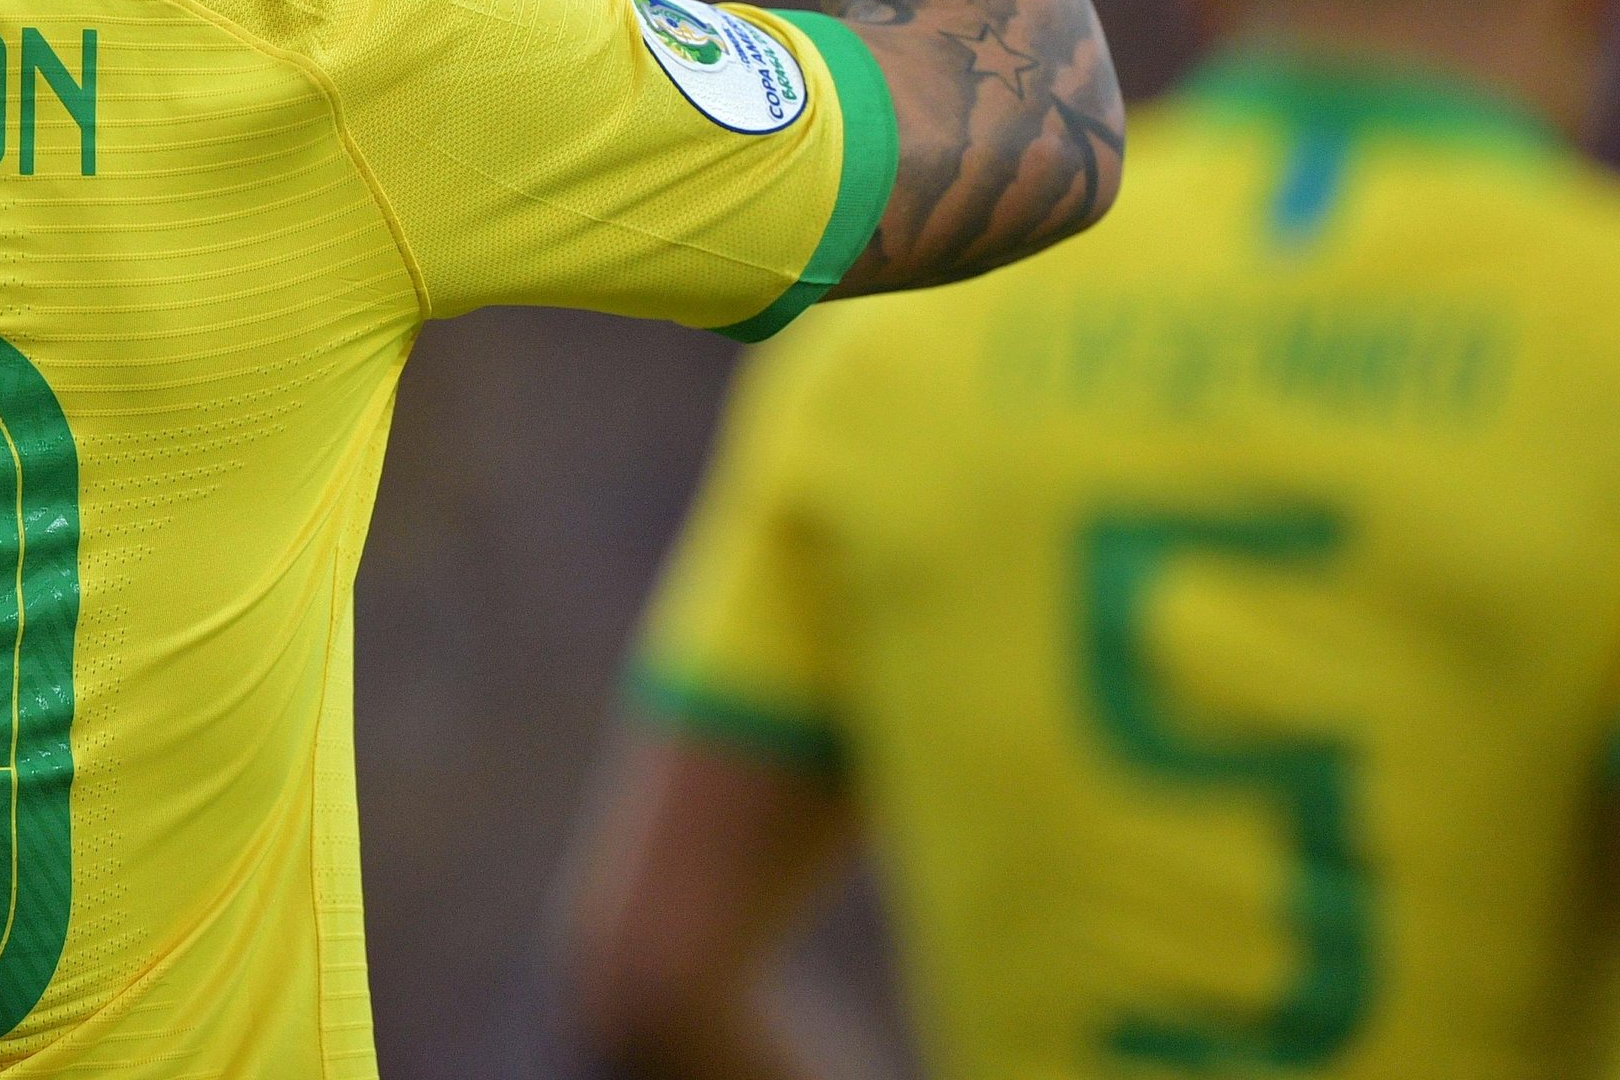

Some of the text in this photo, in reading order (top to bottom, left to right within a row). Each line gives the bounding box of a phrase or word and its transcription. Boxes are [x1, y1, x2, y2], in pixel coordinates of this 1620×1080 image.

[758, 69, 784, 119] COPA
[763, 46, 797, 100] BRASIL
[1081, 507, 1374, 1067] 5
